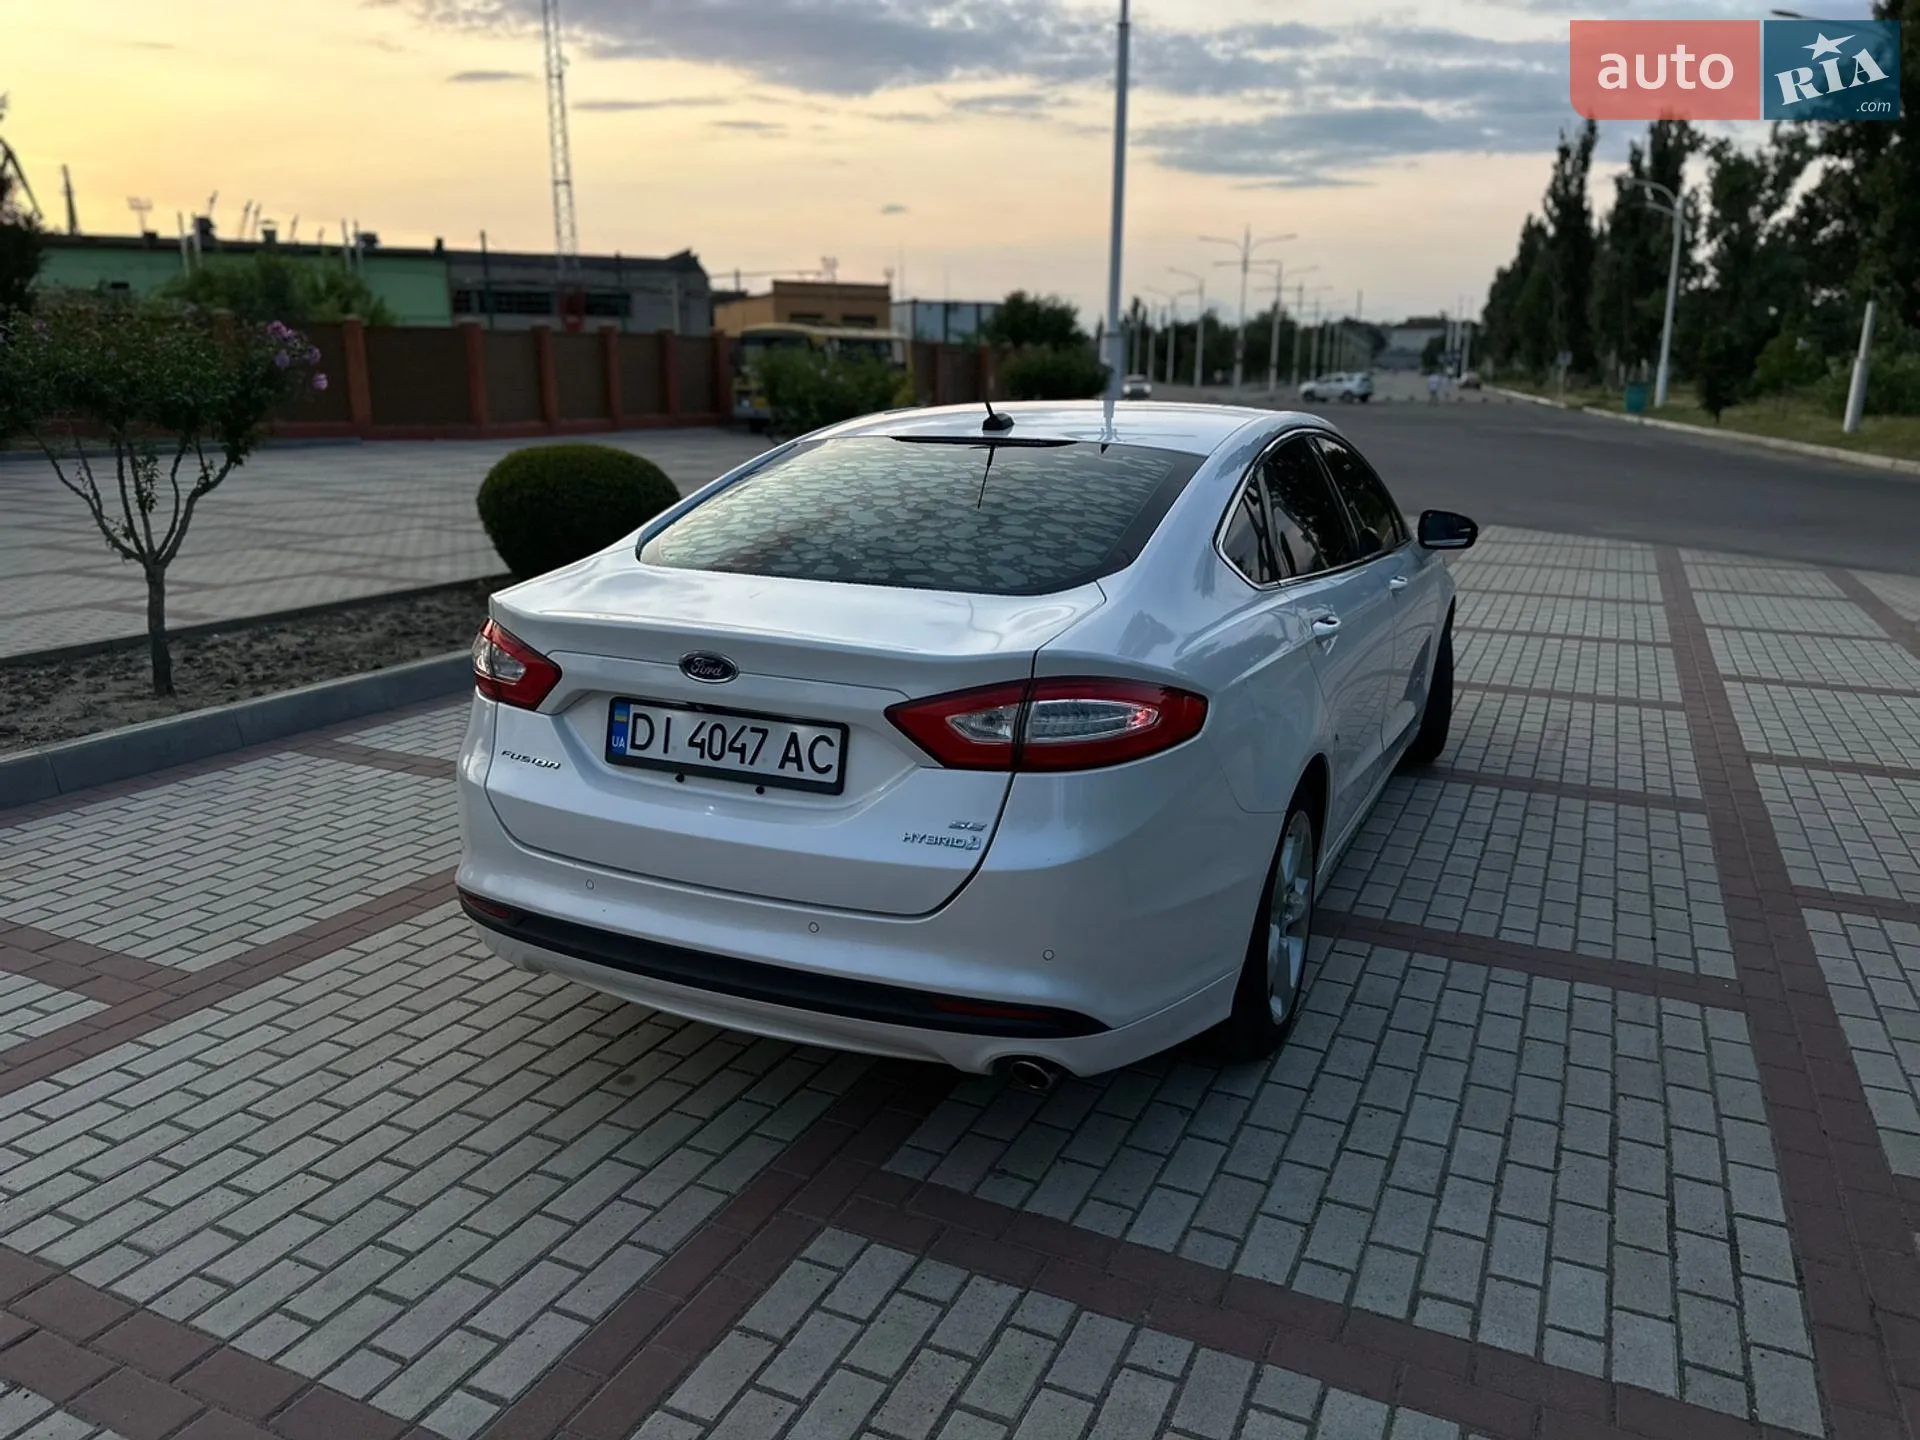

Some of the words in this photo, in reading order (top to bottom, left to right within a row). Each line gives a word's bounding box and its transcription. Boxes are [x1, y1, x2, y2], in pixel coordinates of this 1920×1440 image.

[691, 657, 723, 676] Ford
[612, 736, 626, 748] UA
[630, 712, 672, 754] DI
[687, 720, 769, 765] 4047
[778, 731, 835, 774] AC
[902, 832, 967, 849] HYBRID
